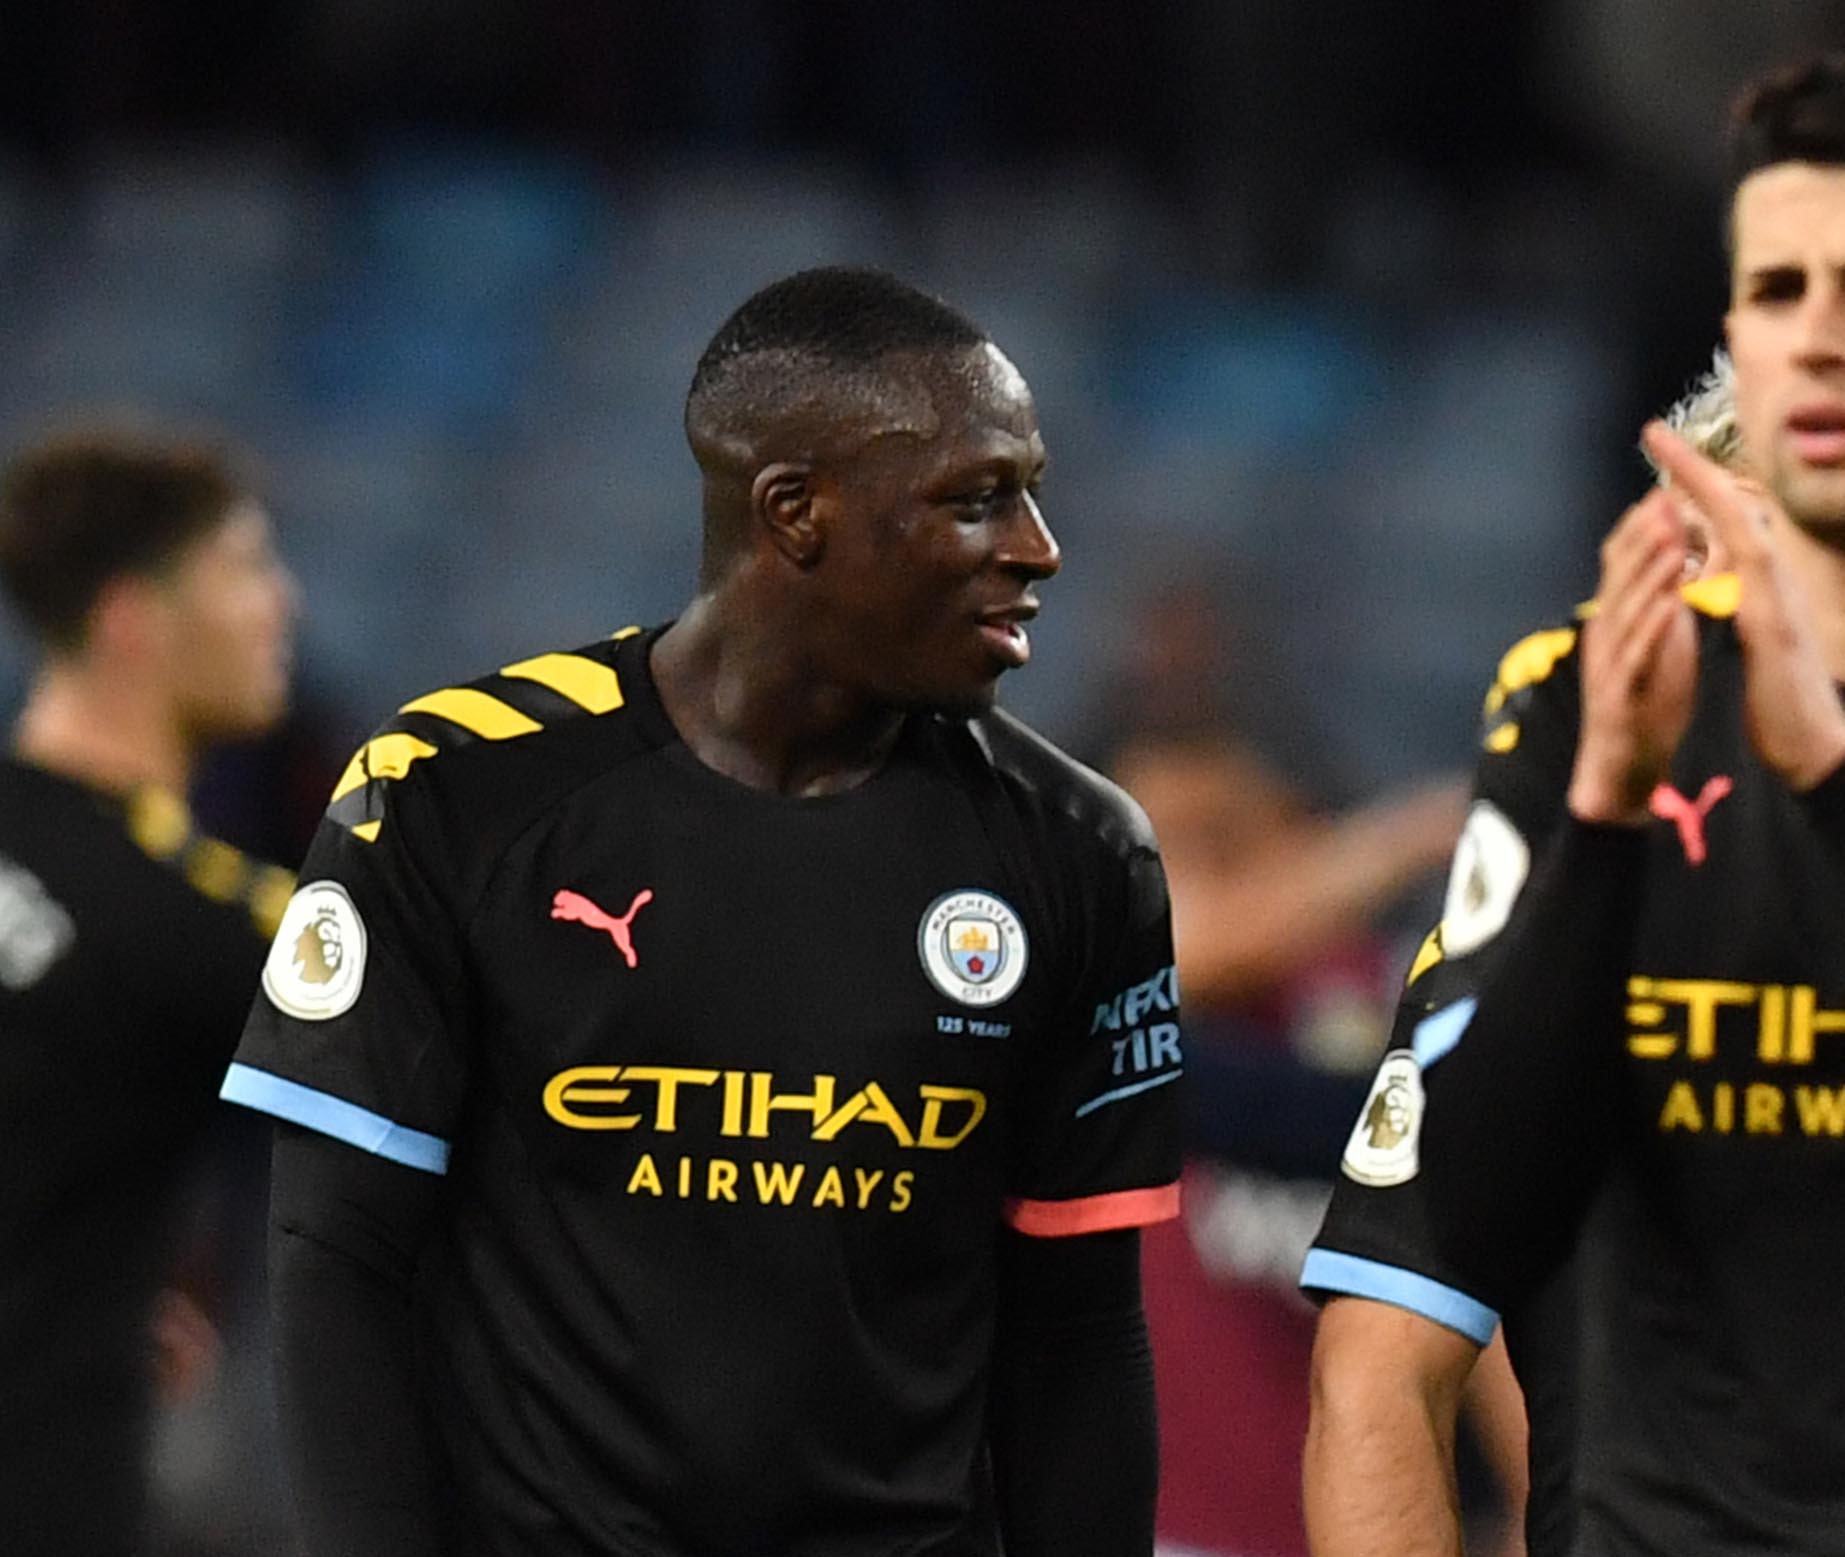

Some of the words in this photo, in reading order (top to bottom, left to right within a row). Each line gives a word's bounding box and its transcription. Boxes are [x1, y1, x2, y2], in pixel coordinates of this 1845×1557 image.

[932, 899, 1017, 935] MANCHESTER
[1112, 1023, 1183, 1077] TIR
[541, 1065, 987, 1151] ETIHAD
[626, 1153, 916, 1213] AIRWAYS
